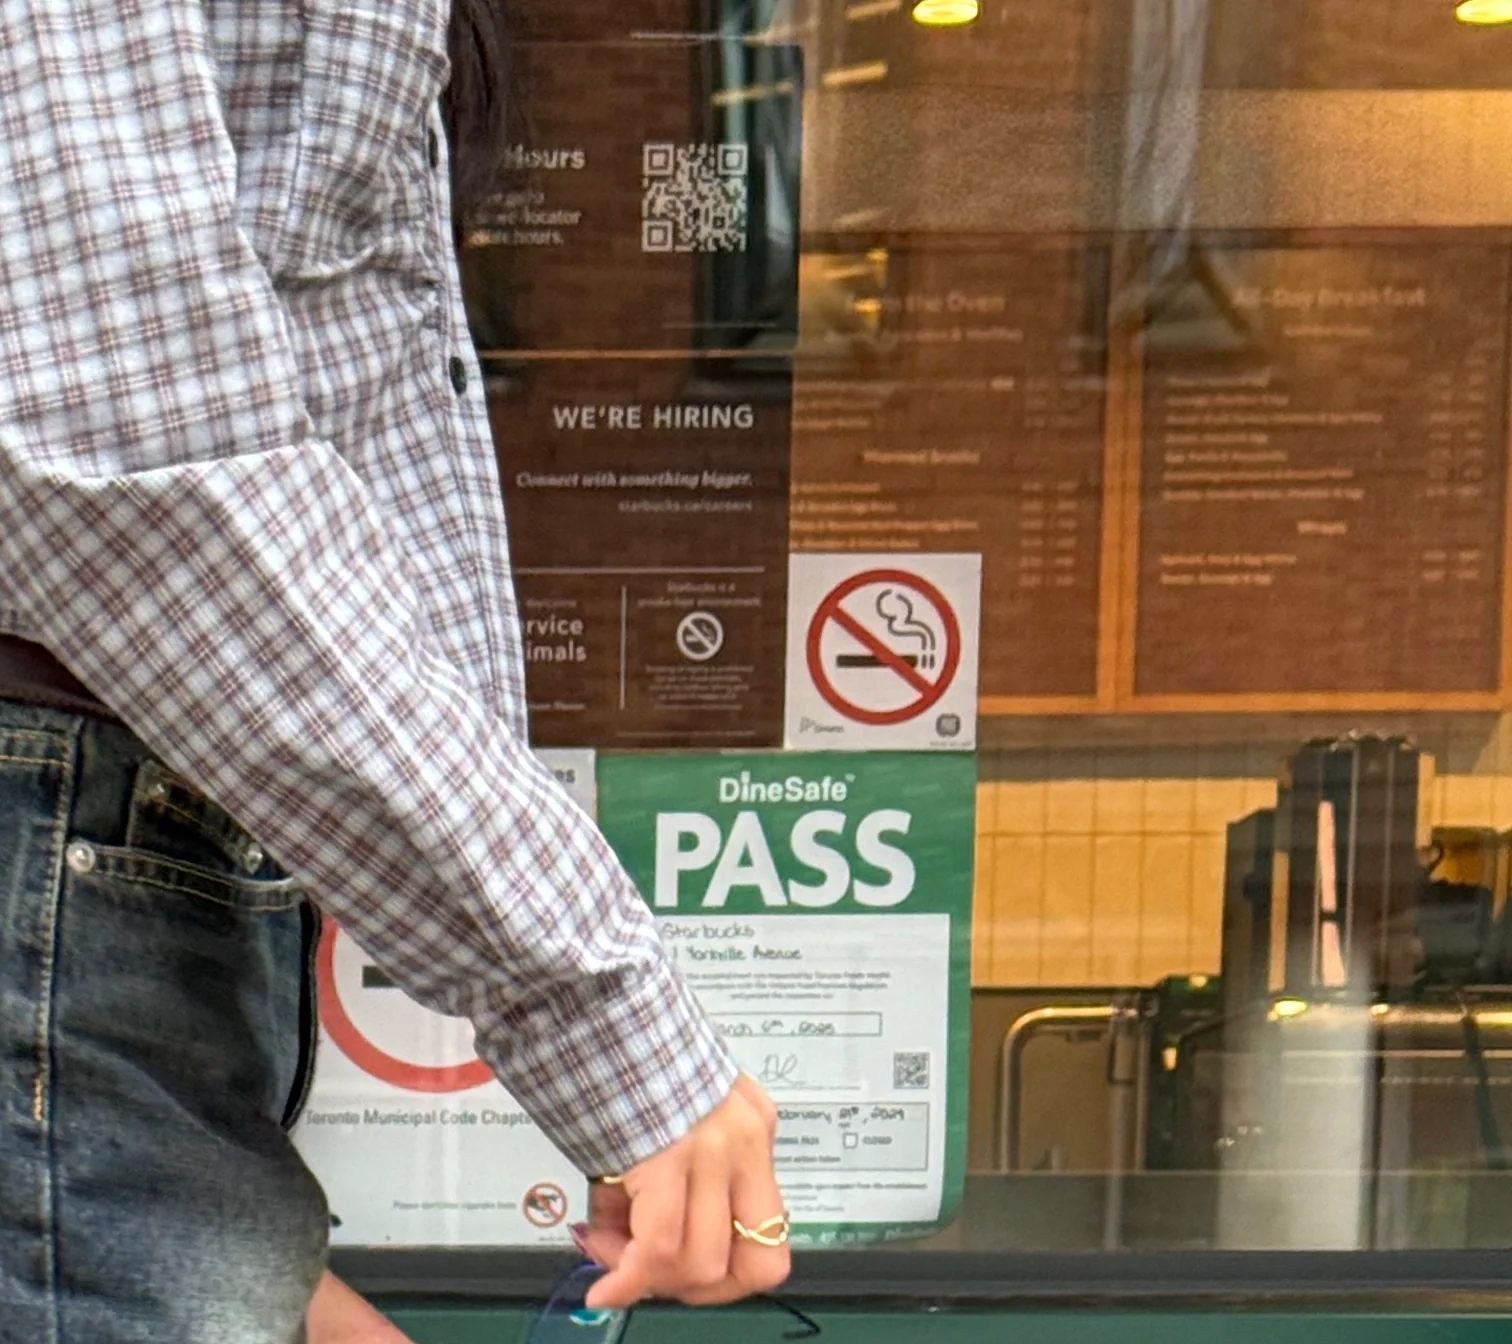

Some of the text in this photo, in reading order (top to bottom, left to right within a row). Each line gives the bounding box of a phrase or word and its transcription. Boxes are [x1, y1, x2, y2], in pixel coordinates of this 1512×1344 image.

[553, 404, 754, 430] WE'RE HIRING
[516, 470, 753, 490] Connect with something bigger.
[526, 614, 584, 636] rvice
[526, 638, 587, 662] imals
[719, 771, 849, 803] DineSafe
[653, 808, 917, 909] PASS
[662, 921, 756, 940] Starbucks
[364, 1109, 436, 1127] Municipal
[440, 1109, 477, 1125] Code
[481, 1109, 533, 1127] Chapte
